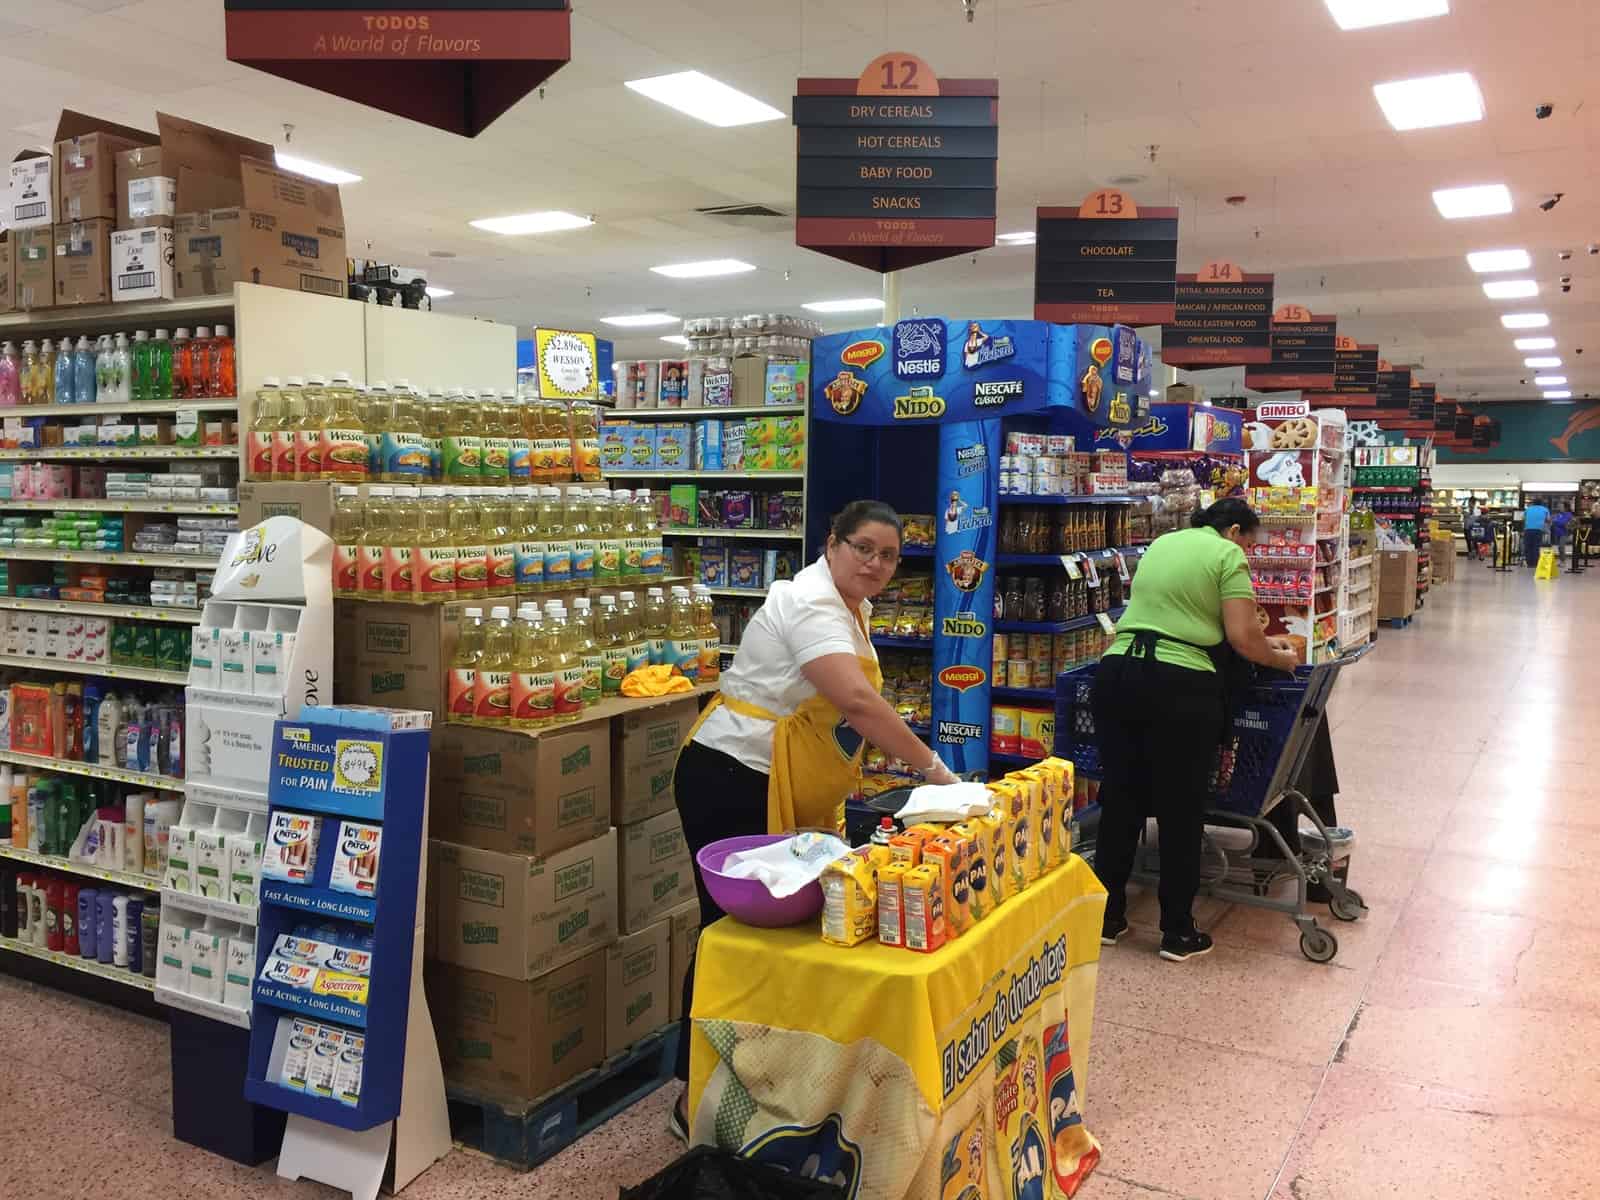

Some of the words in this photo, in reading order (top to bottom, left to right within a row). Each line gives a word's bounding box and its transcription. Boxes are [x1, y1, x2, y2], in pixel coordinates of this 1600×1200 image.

[364, 16, 430, 30] TODOS
[314, 36, 328, 51] A
[332, 35, 384, 52] World
[391, 35, 409, 55] of
[417, 35, 481, 52] Flavors
[880, 61, 919, 90] 12
[851, 105, 875, 118] DRY
[879, 105, 933, 118] CEREALS
[857, 135, 884, 148] HOT
[887, 136, 941, 148] CEREALS
[860, 166, 892, 179] BABY
[896, 166, 932, 179] FOOD
[872, 196, 921, 209] SNACKS
[1096, 193, 1123, 214] 13
[1080, 245, 1135, 257] CHOCOLATE
[1208, 263, 1232, 280] 14
[1097, 287, 1115, 298] TEA
[1175, 287, 1201, 296] ENTRAL
[1243, 287, 1265, 296] FOOD
[1244, 303, 1266, 313] FOOD
[1285, 306, 1301, 320] 15
[1235, 319, 1257, 329] FOOD
[1222, 335, 1244, 344] FOOD
[1336, 337, 1350, 348] 16
[896, 399, 941, 416] NIDO
[1260, 406, 1306, 418] BIMBO
[331, 430, 362, 442] Wesso
[397, 433, 423, 444] Wesso
[484, 438, 509, 448] Wesso
[430, 549, 454, 560] Wess
[457, 548, 486, 560] Wesso
[944, 620, 985, 635] NIDO
[257, 641, 273, 650] Dove
[304, 669, 319, 708] ove
[278, 753, 329, 772] TRUSTED
[280, 776, 298, 787] FOR
[299, 775, 329, 791] PAIN
[276, 815, 290, 828] ICY
[344, 825, 358, 839] ICY
[347, 840, 371, 851] PATCH
[264, 889, 282, 899] FAST
[282, 893, 310, 906] ACTING
[316, 899, 338, 912] LONG
[339, 904, 370, 917] LASTING
[320, 979, 366, 993] Aspercreme
[256, 985, 274, 997] FAST
[275, 989, 302, 1005] ACTING
[308, 997, 329, 1013] LONG
[330, 1002, 361, 1018] LASTING
[943, 1040, 955, 1099] El
[957, 1016, 991, 1084] sabor
[992, 989, 1007, 1041] de
[1008, 954, 1040, 1024] donde
[1050, 1089, 1081, 1133] PA
